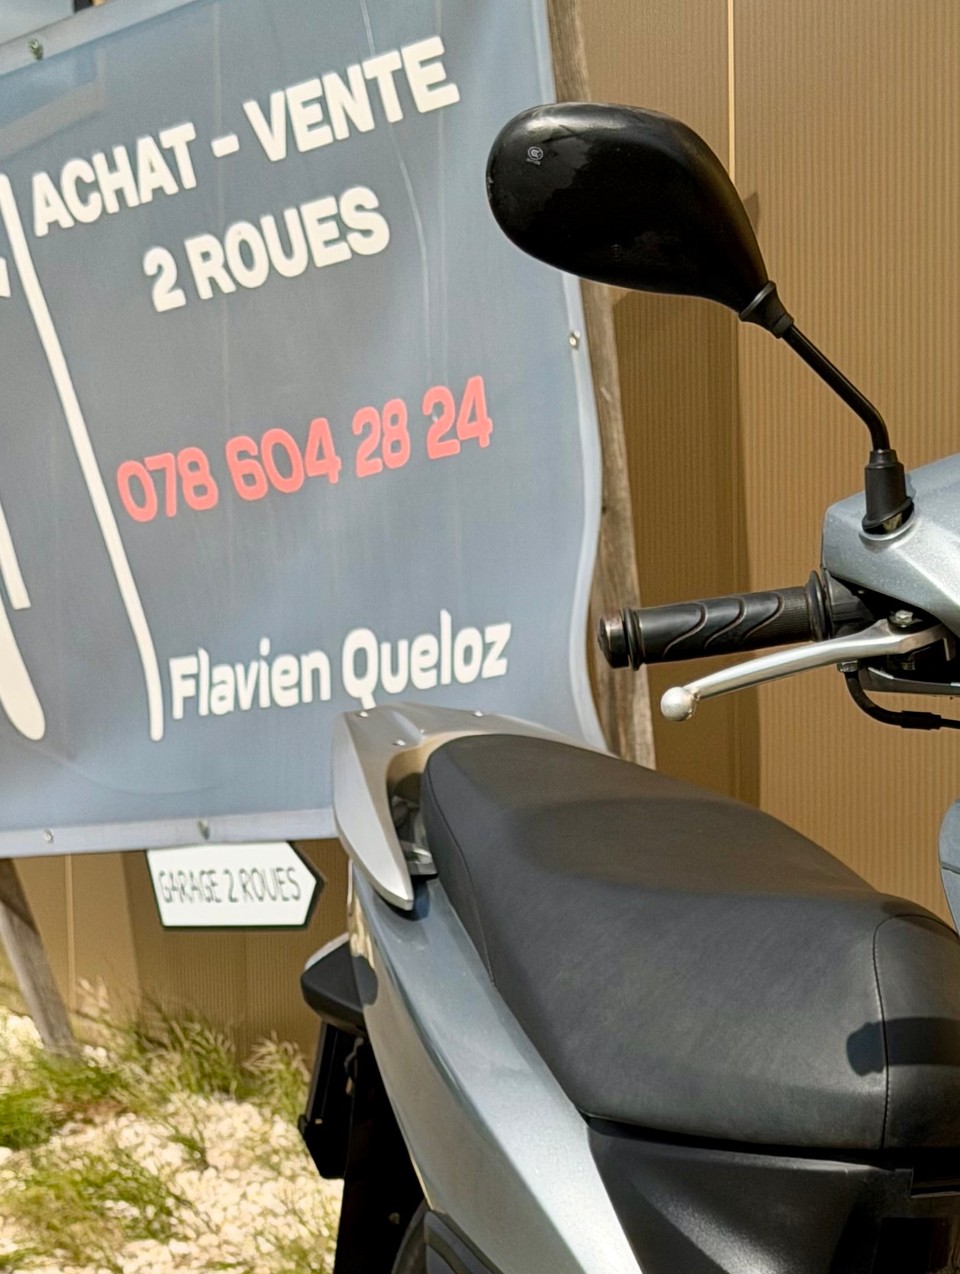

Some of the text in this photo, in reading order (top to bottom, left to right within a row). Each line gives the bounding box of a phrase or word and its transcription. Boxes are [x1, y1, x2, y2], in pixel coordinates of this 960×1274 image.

[32, 122, 198, 238] ACHAT
[242, 34, 461, 163] VENTE
[143, 185, 391, 313] 2 ROUES
[116, 375, 494, 523] 078 604 28 24
[168, 608, 512, 720] Flavien Queloz
[158, 866, 302, 904] GARAGE 2 ROUES
